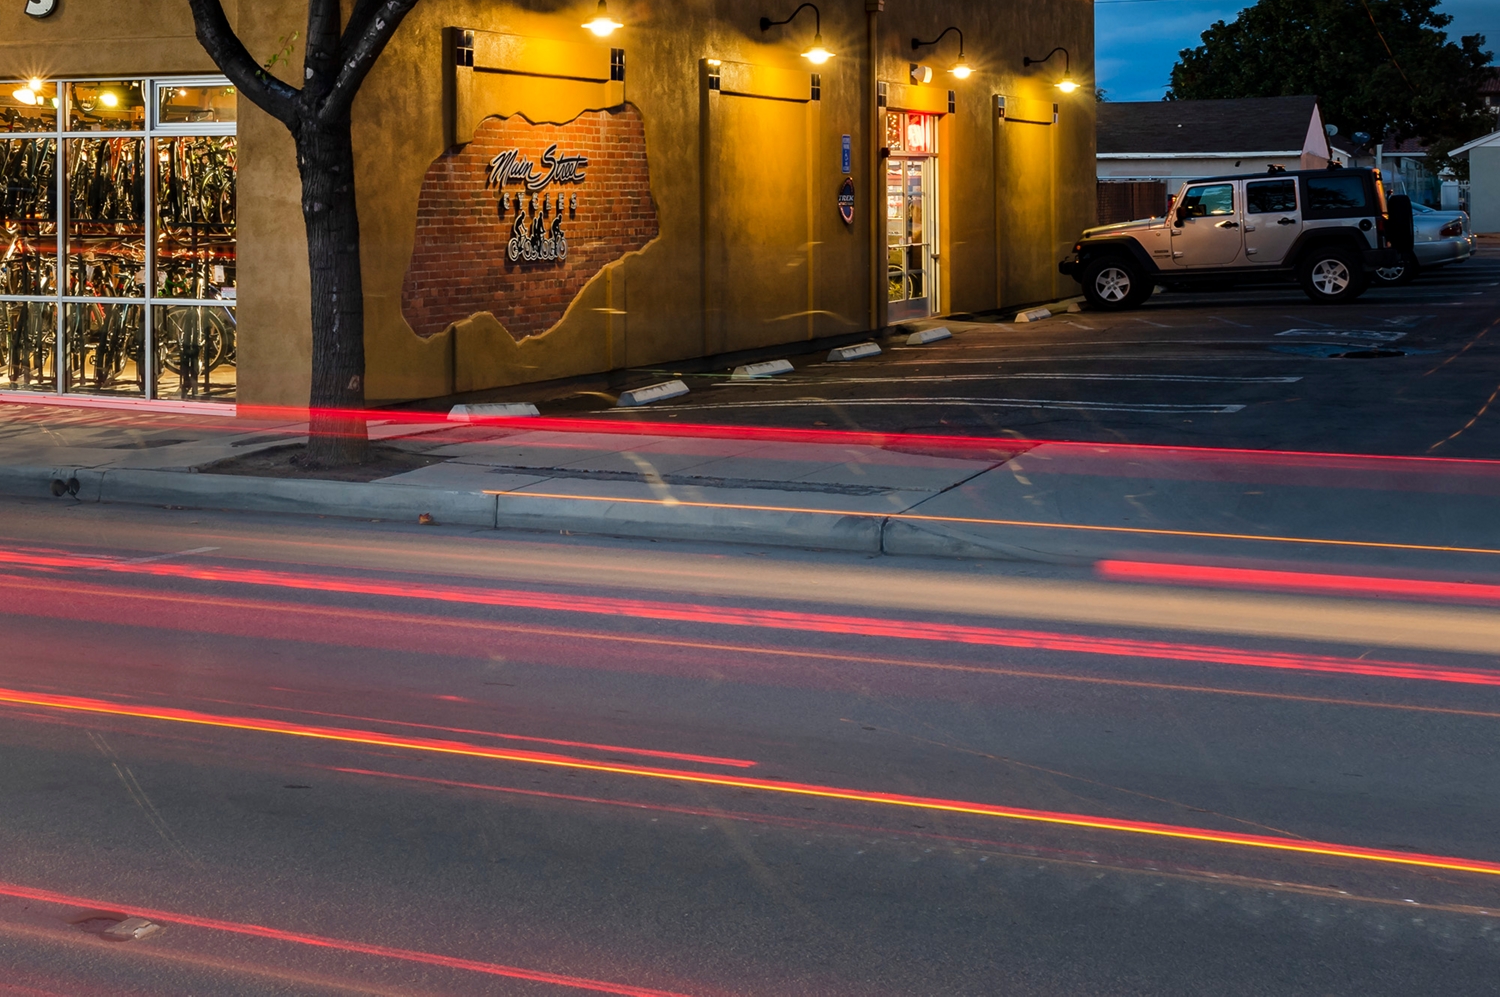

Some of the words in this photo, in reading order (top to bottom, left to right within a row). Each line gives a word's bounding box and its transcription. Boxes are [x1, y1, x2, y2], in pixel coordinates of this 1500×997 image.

[489, 149, 542, 187] Main
[527, 143, 588, 190] Street
[503, 192, 577, 210] CYCLES
